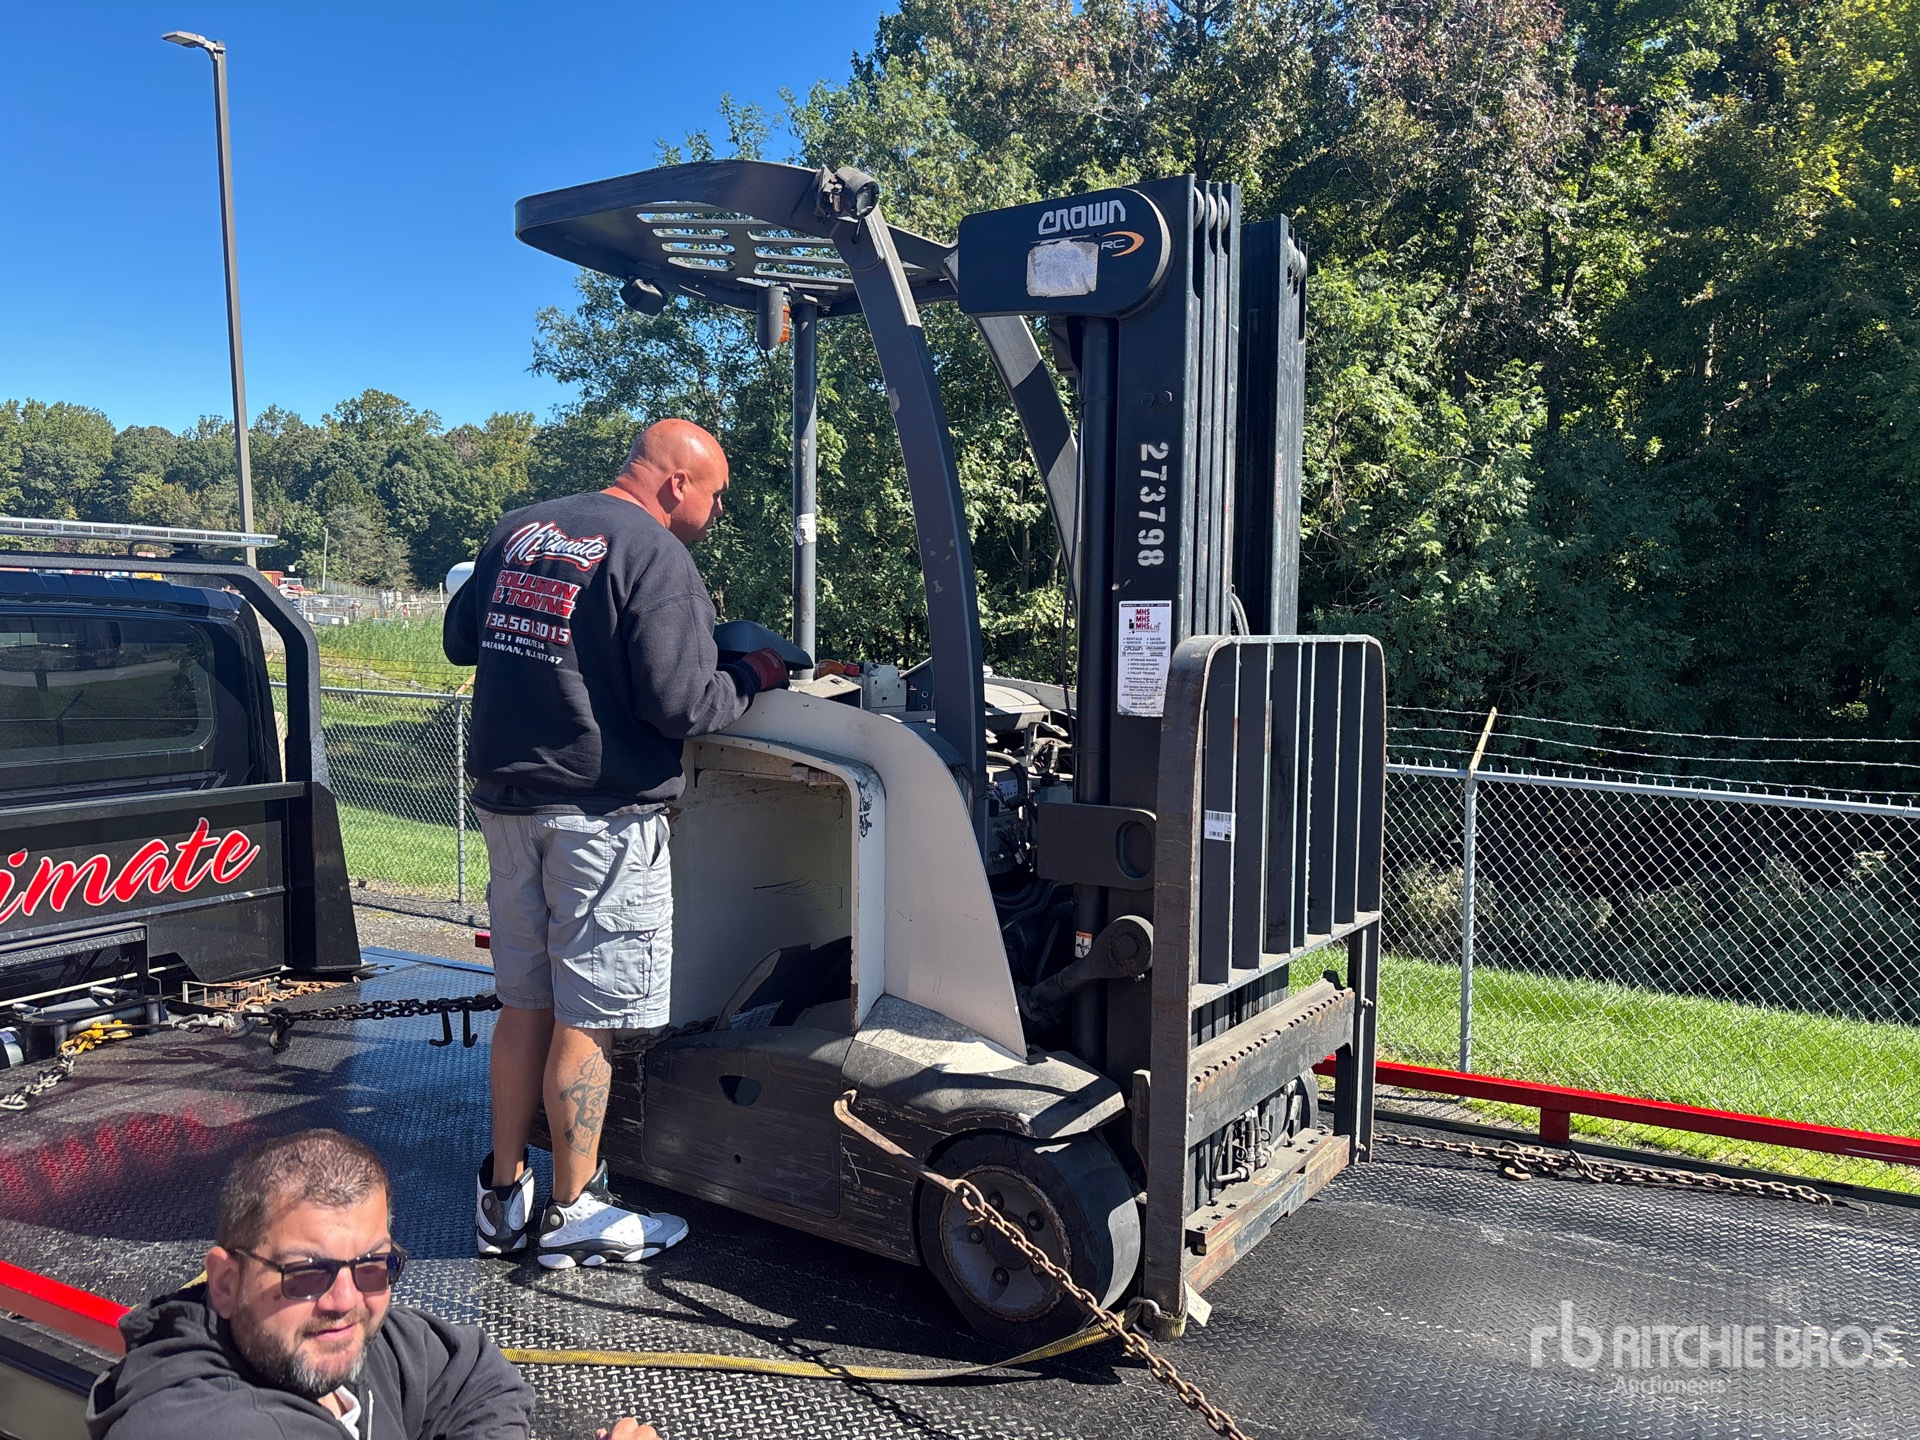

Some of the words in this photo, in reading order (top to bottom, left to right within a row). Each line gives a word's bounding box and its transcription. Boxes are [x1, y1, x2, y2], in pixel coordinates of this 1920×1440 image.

[1038, 199, 1126, 235] CROWN
[1101, 238, 1126, 250] RC
[1137, 441, 1169, 567] 273798
[502, 521, 608, 570] Ultimate
[496, 570, 582, 601] COLLSION
[492, 586, 504, 603] &
[1136, 608, 1151, 616] MHS
[1136, 615, 1151, 623] MHS
[494, 632, 512, 642] 231
[515, 636, 538, 648] ROUTE
